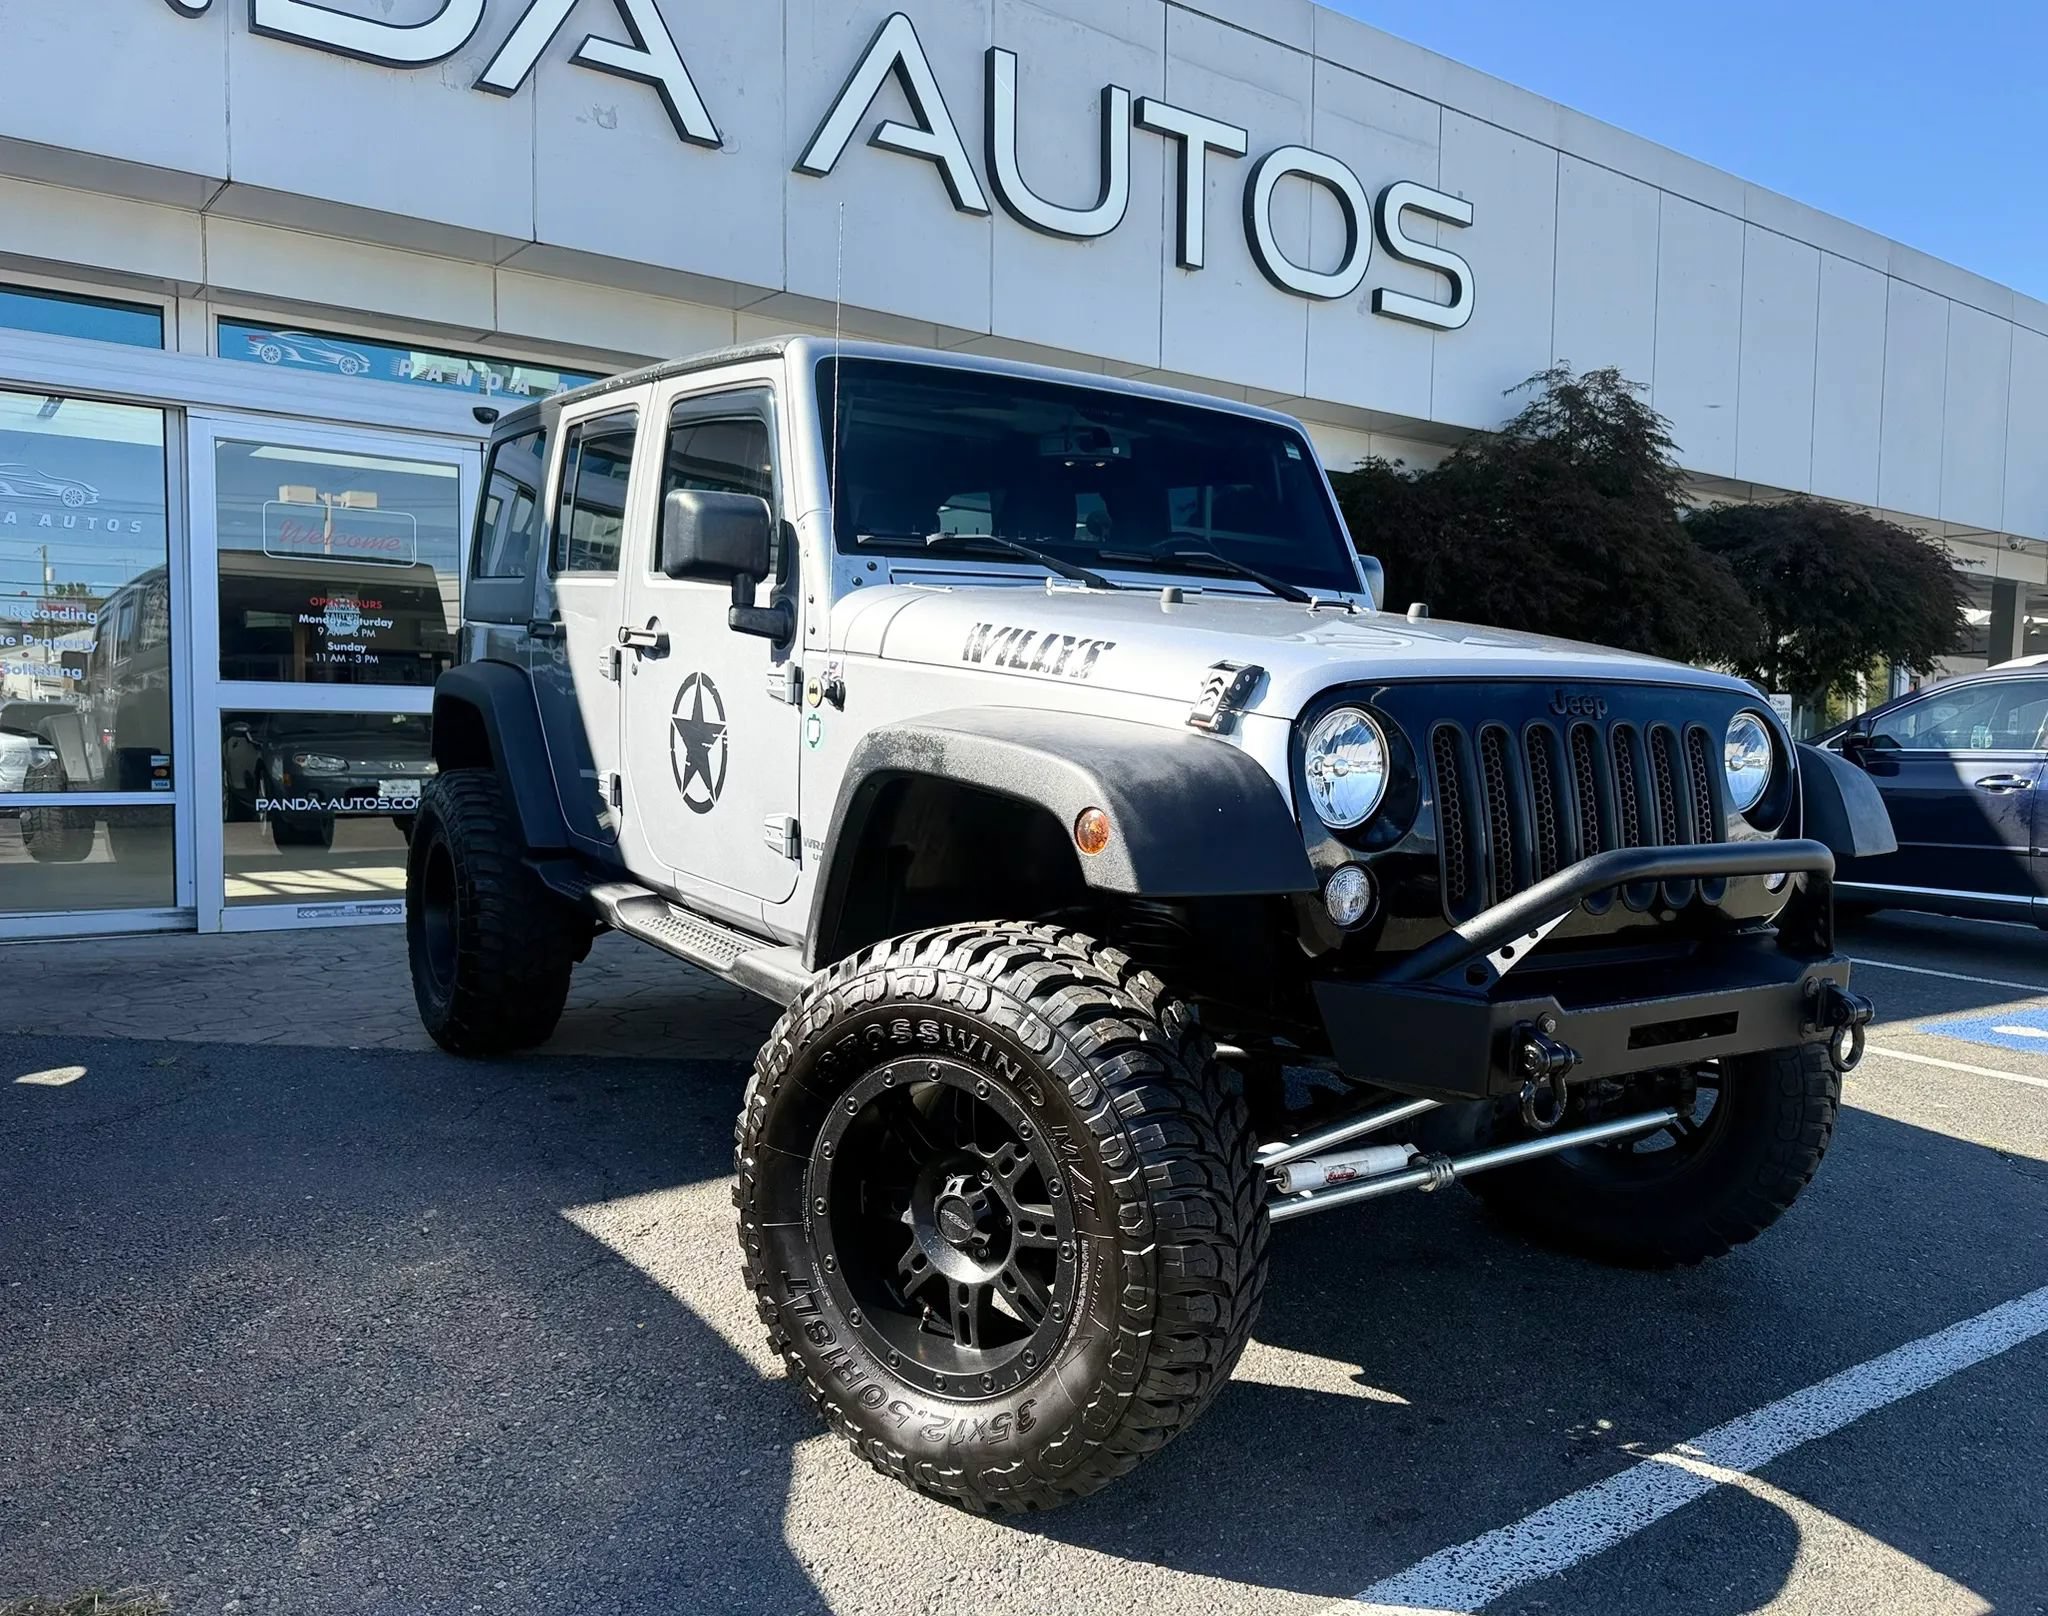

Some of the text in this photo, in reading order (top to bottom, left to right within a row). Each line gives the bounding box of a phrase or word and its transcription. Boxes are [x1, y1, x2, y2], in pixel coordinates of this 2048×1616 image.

[791, 11, 1476, 330] AUTOS
[398, 359, 530, 395] PANDA
[38, 514, 142, 533] AUTOS
[280, 519, 400, 550] Welcome
[9, 605, 98, 624] Recording
[317, 626, 325, 636] 9
[361, 629, 376, 638] PM
[22, 634, 99, 653] Property
[327, 641, 367, 654] Sunday
[316, 653, 326, 662] 11
[330, 654, 346, 663] AM
[355, 654, 362, 664] 3
[364, 655, 379, 664] PM
[1549, 688, 1608, 720] Jeep
